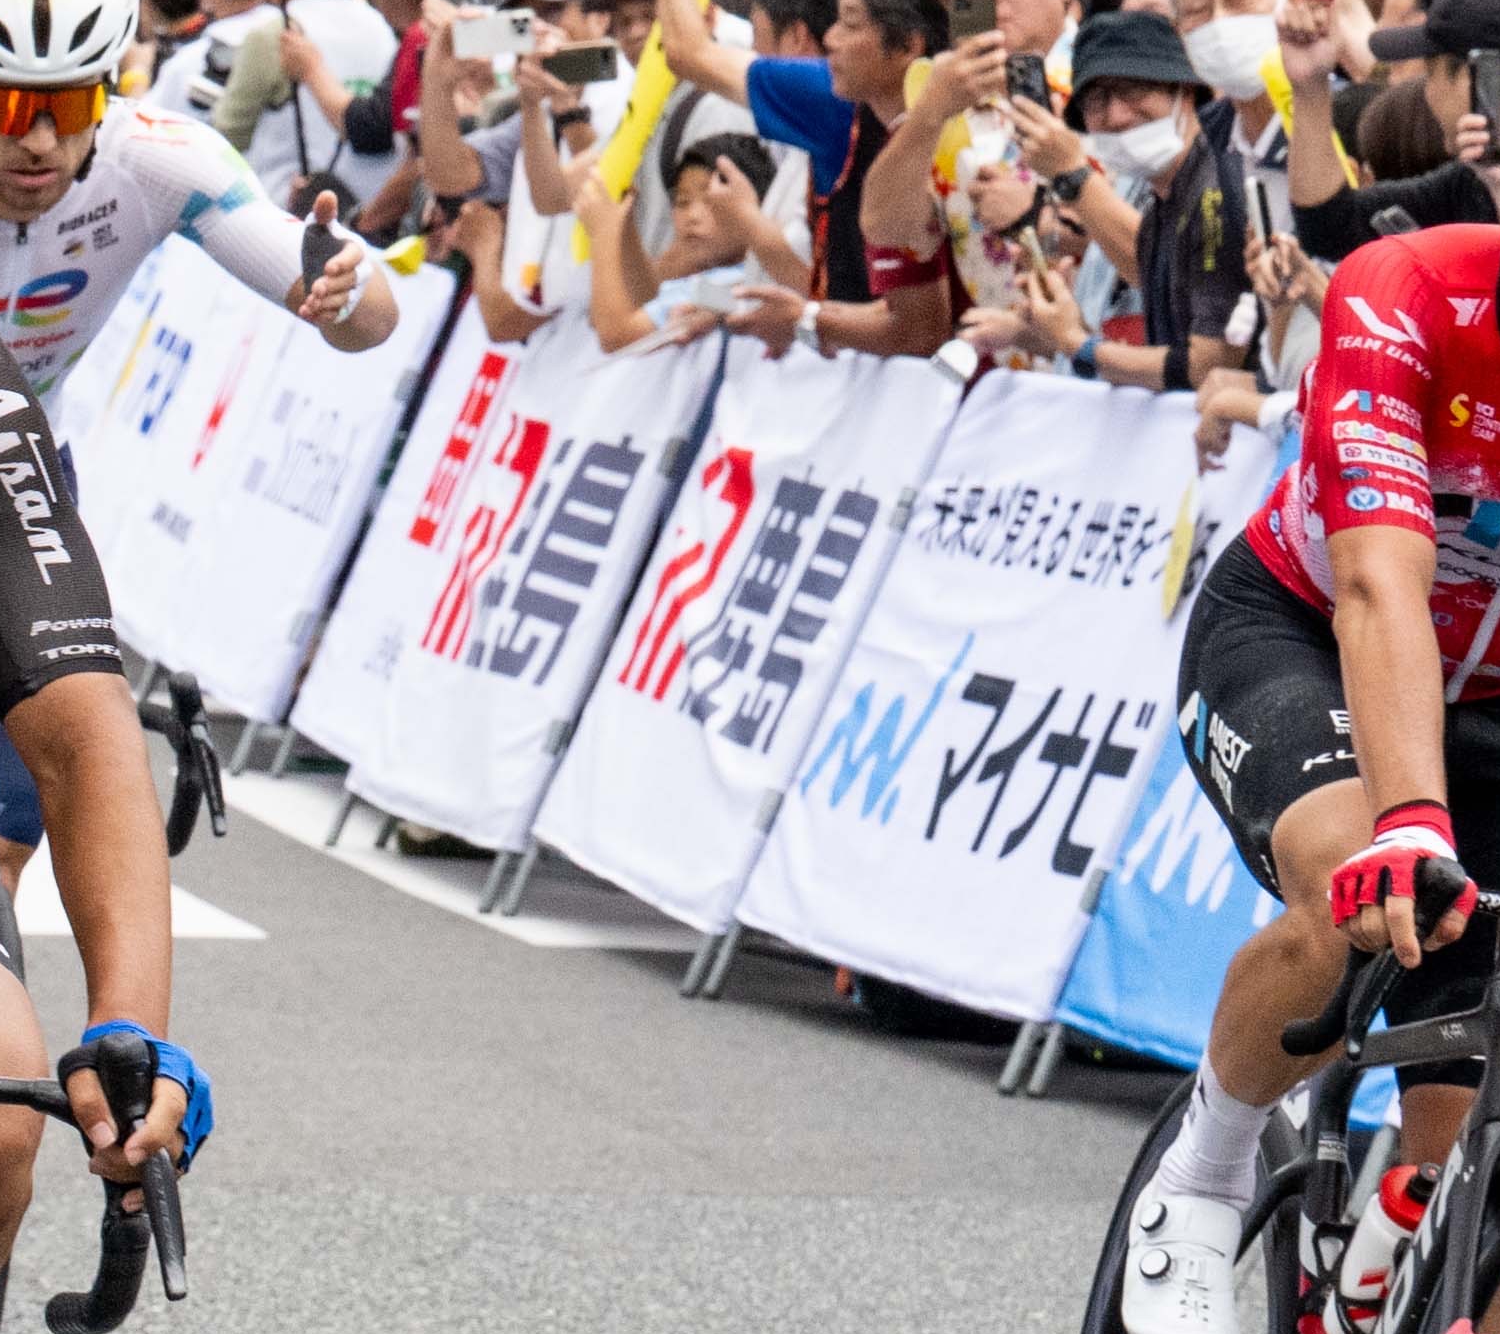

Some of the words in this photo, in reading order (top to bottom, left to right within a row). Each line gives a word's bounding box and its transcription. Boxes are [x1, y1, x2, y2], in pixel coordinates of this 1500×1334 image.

[1336, 335, 1382, 352] TEAM
[925, 671, 1159, 878] マイナビ
